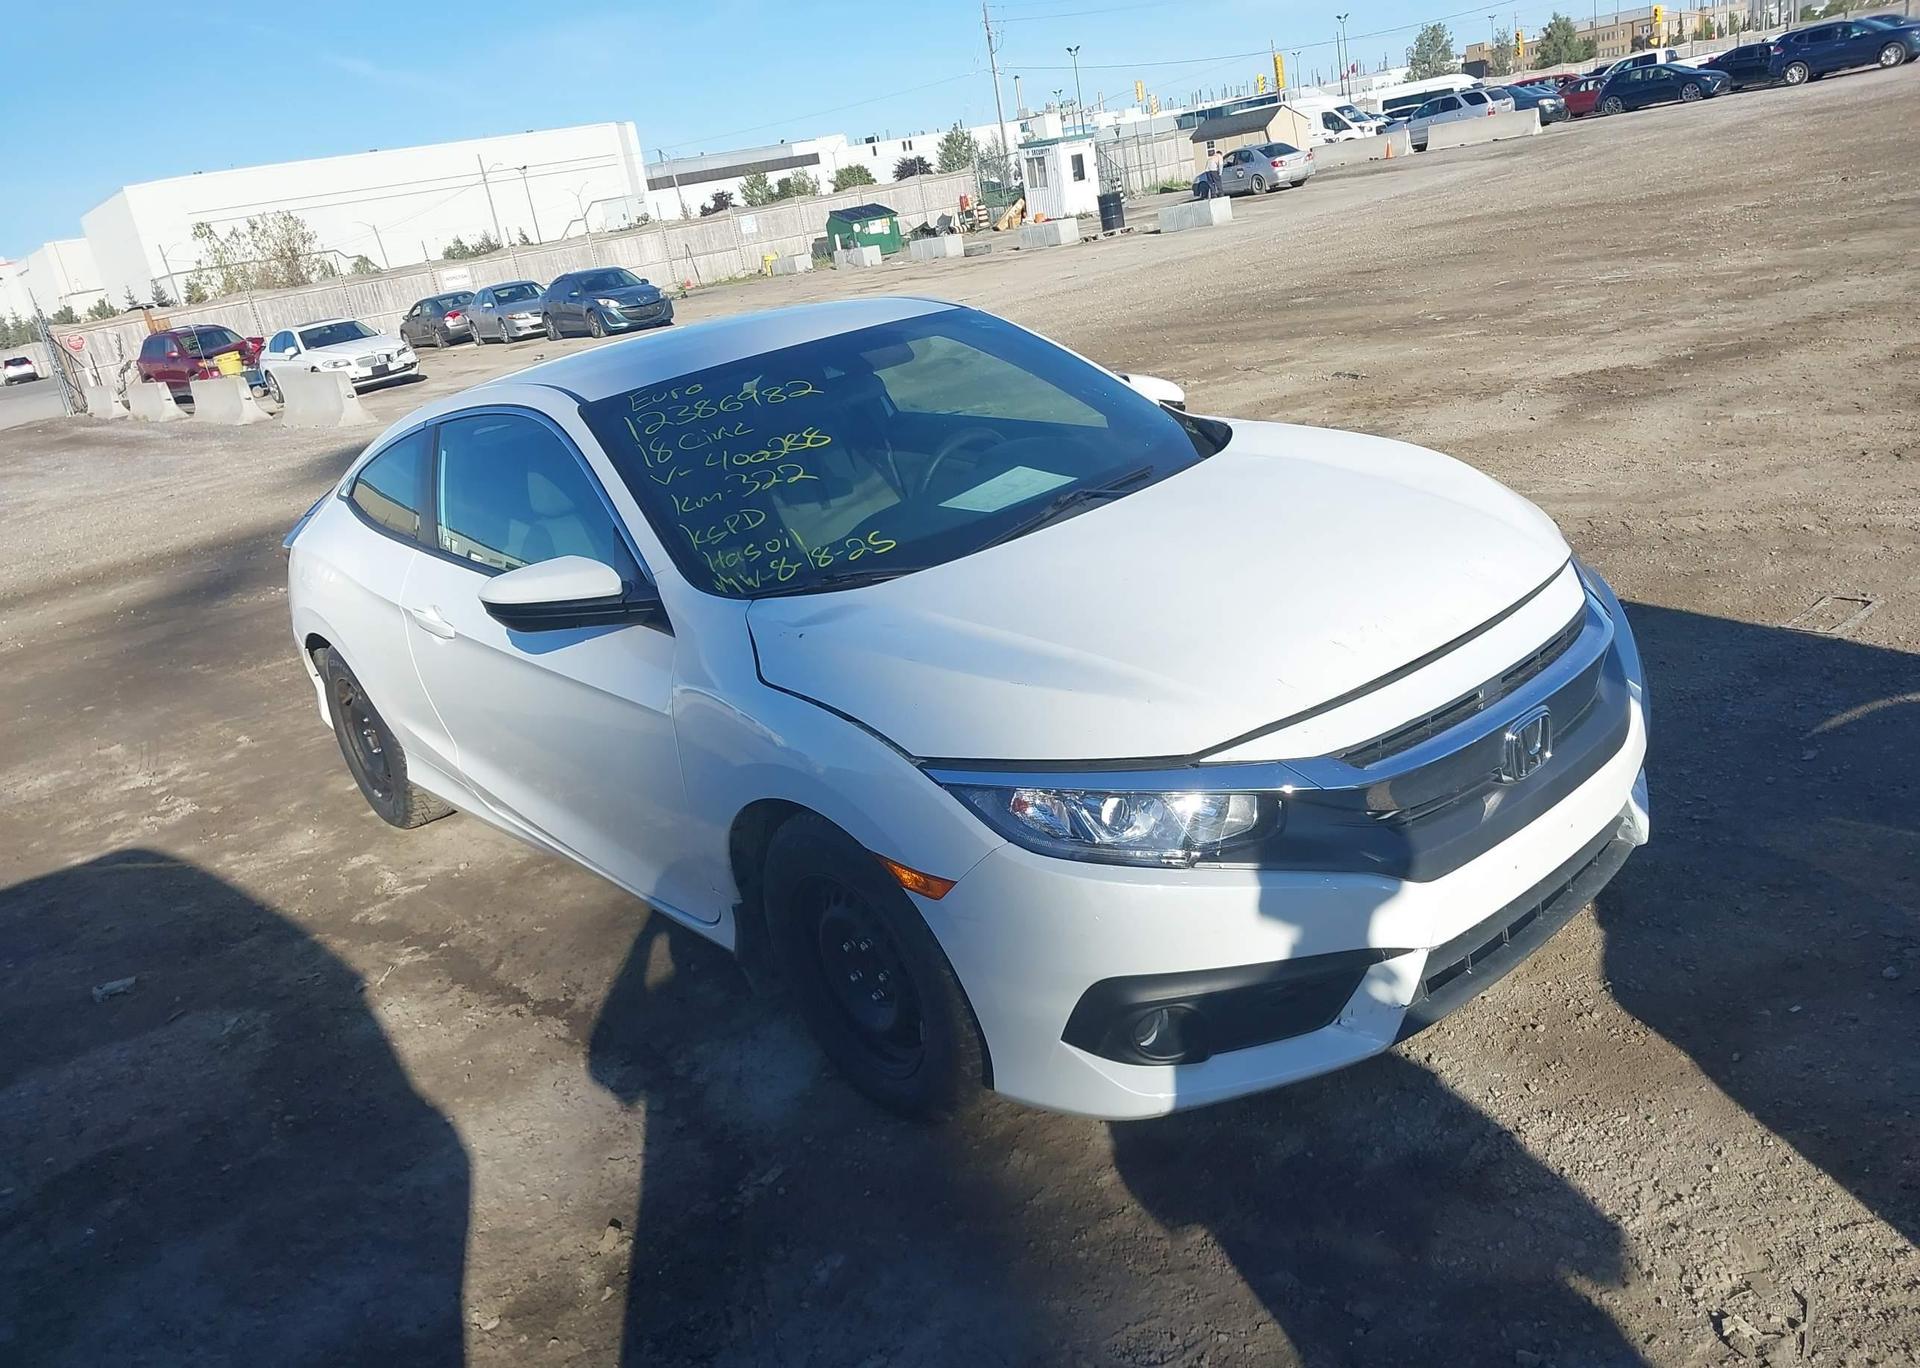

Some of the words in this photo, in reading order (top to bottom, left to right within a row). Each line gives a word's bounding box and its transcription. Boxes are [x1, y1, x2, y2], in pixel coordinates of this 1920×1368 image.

[1031, 148, 1051, 156] SECURITY
[627, 383, 704, 412] Euro
[637, 436, 673, 468] 18
[724, 463, 820, 498] 322
